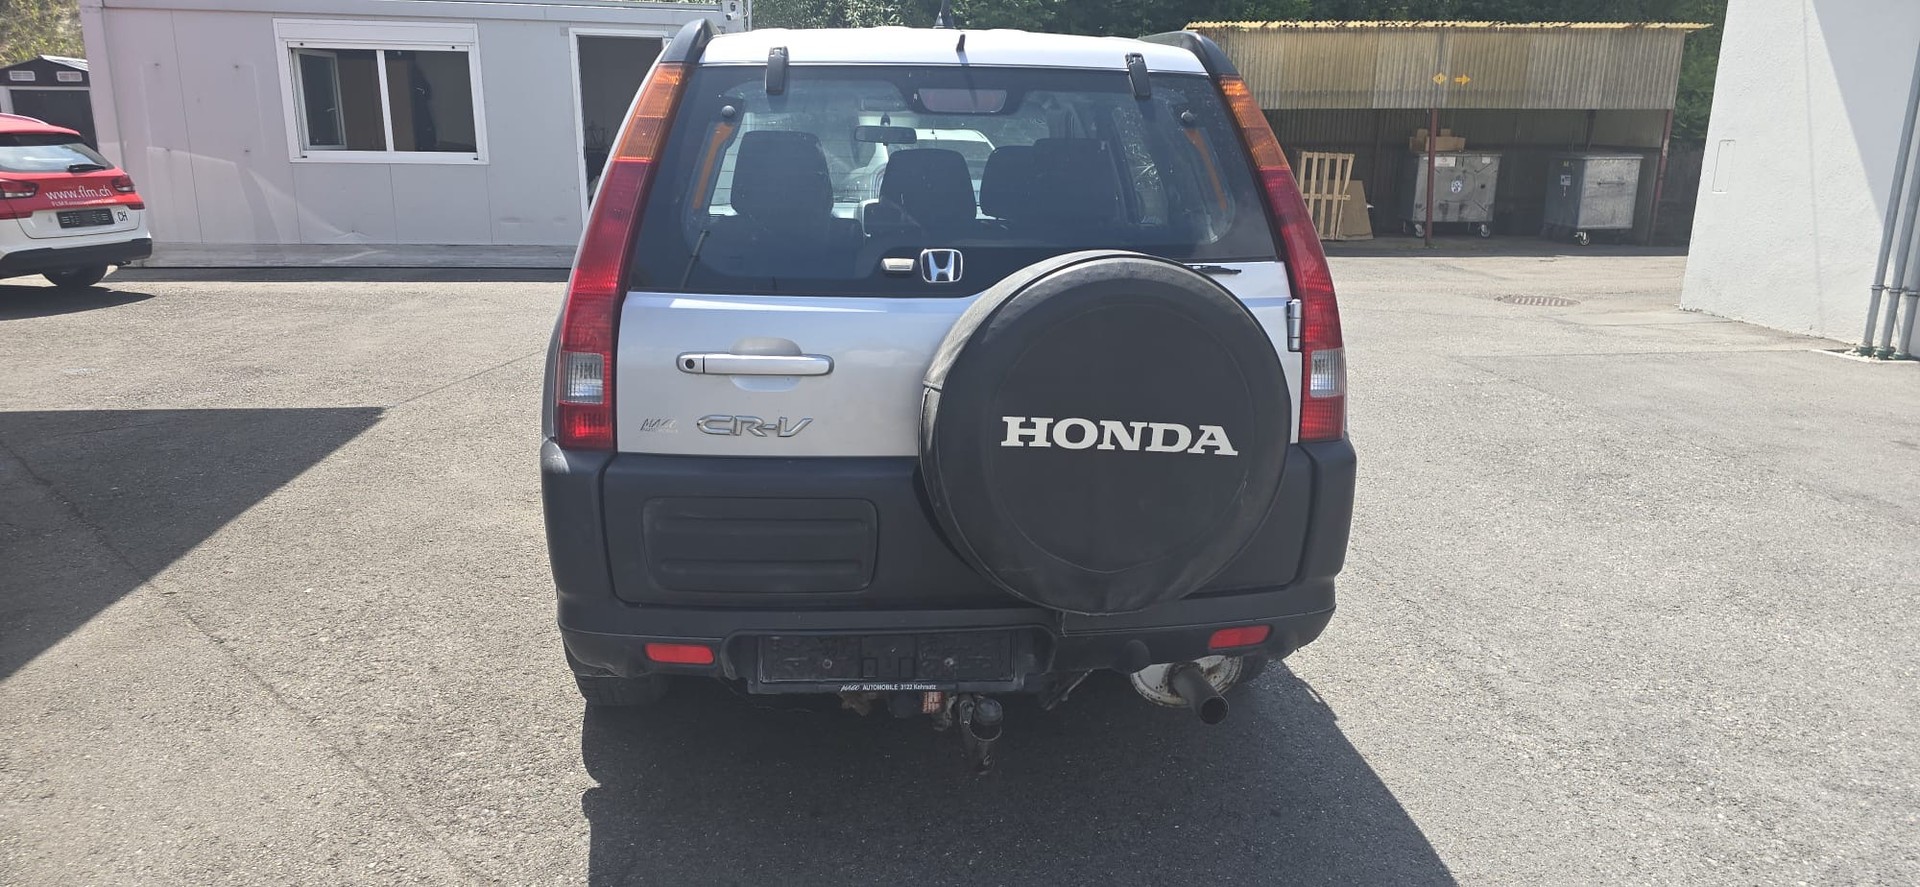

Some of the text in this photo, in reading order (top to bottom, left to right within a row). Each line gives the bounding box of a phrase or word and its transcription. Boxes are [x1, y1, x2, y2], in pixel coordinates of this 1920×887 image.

[46, 185, 112, 200] www.flm.ch
[117, 211, 128, 221] CH
[696, 414, 814, 437] CR-V
[1001, 416, 1239, 456] HONDA
